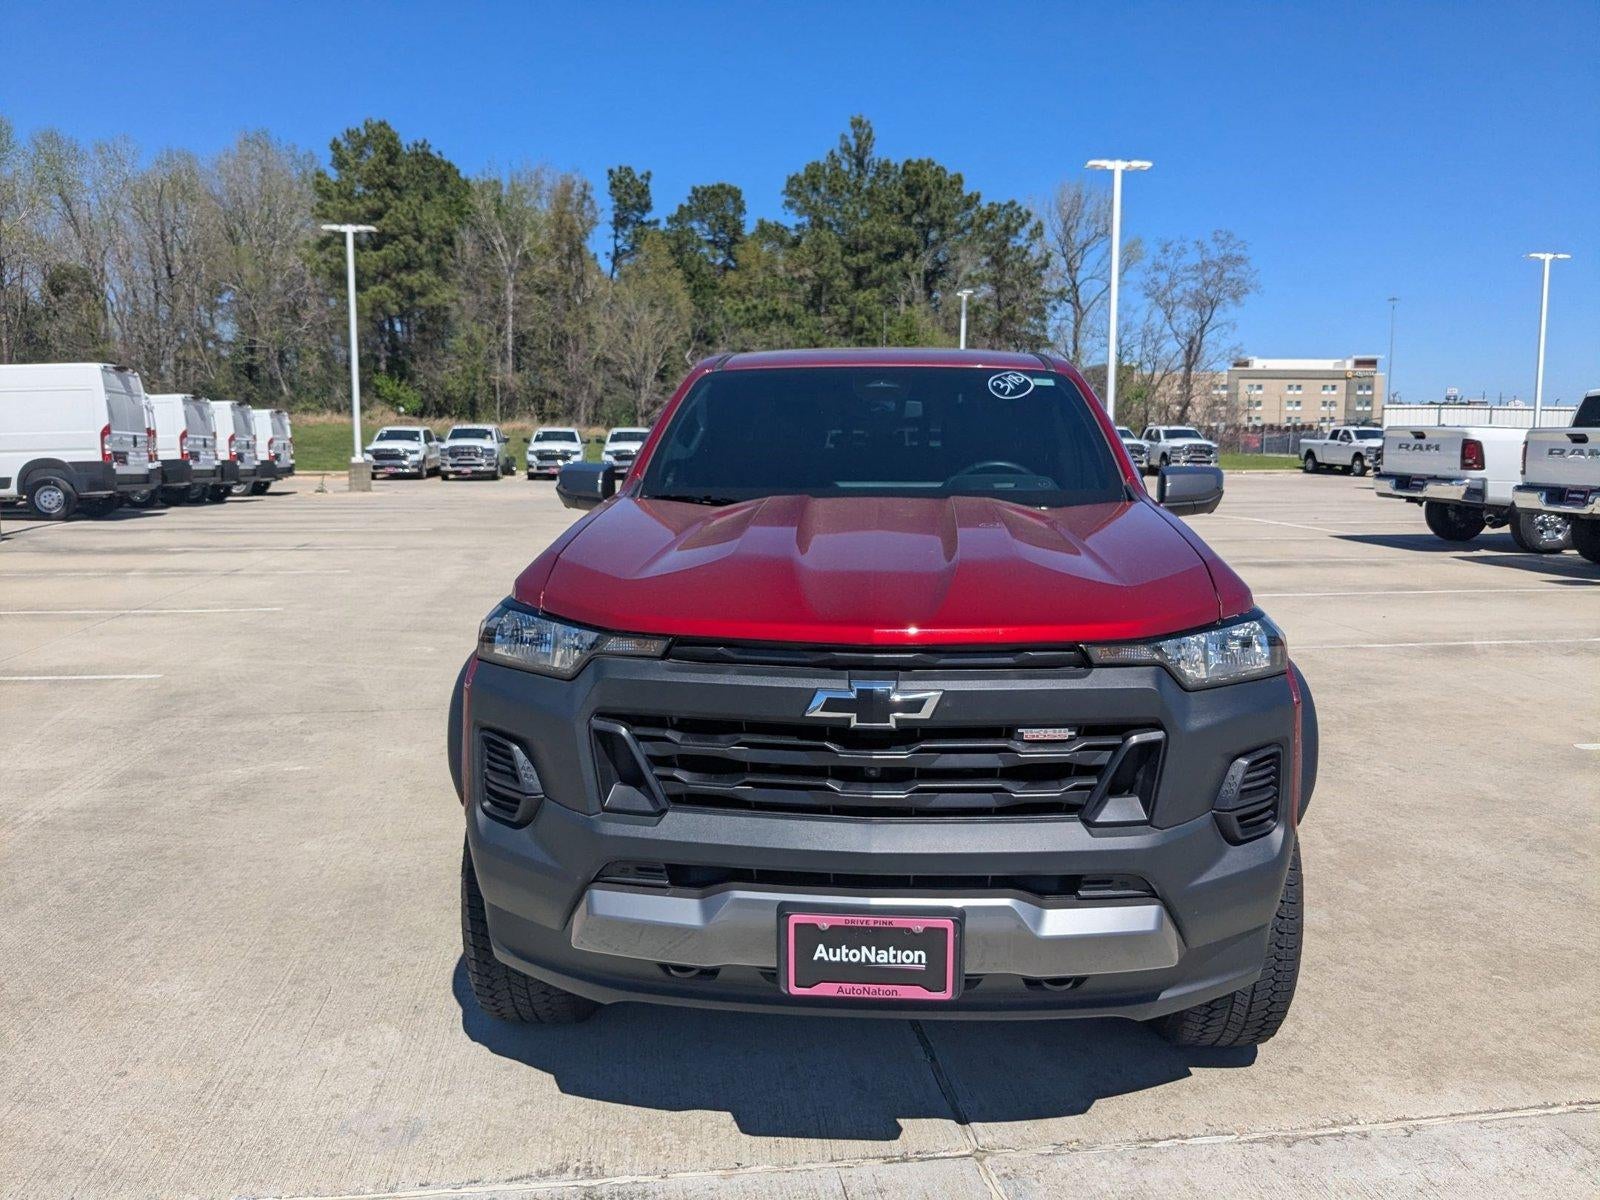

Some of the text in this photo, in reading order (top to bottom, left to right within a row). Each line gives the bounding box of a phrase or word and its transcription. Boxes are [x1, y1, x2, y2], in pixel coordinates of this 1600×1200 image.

[1398, 443, 1440, 451] RAM
[844, 918, 894, 927] DRIVE PINK
[812, 943, 927, 964] AutoNation
